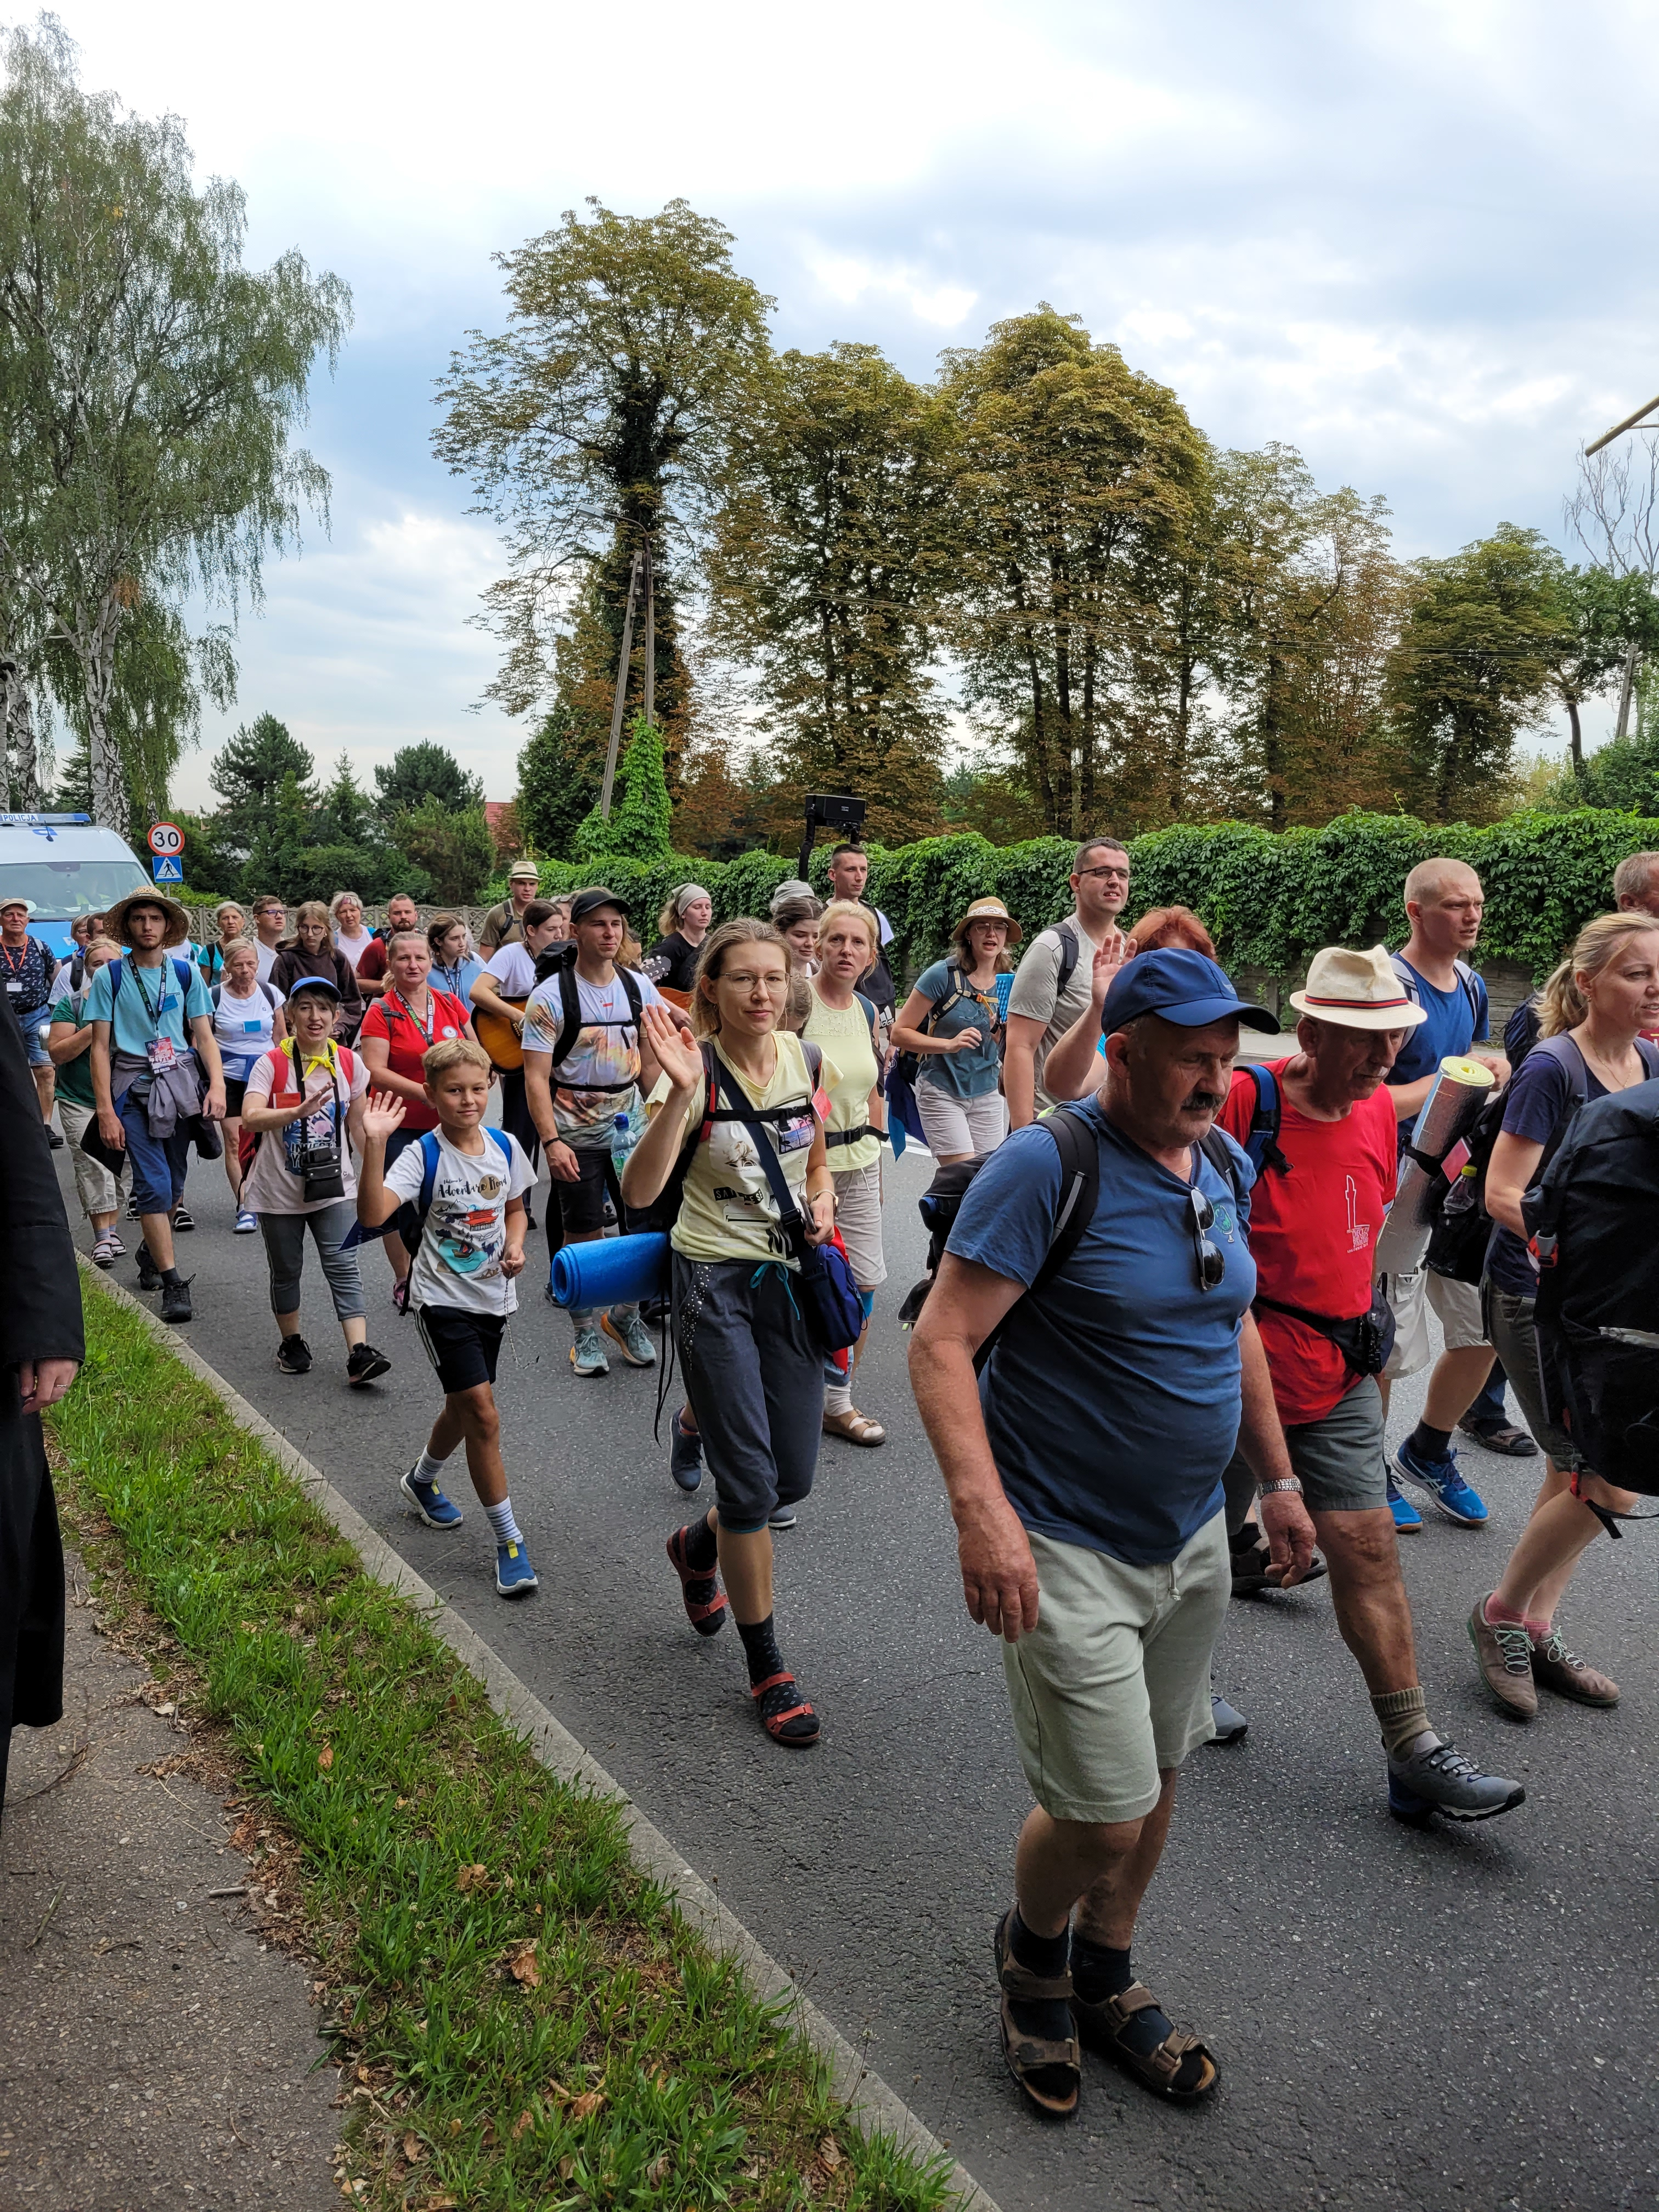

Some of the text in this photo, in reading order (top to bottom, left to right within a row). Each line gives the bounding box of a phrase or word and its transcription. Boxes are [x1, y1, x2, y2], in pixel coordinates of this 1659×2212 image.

[154, 832, 179, 848] 30
[438, 1174, 507, 1198] Adventure Road
